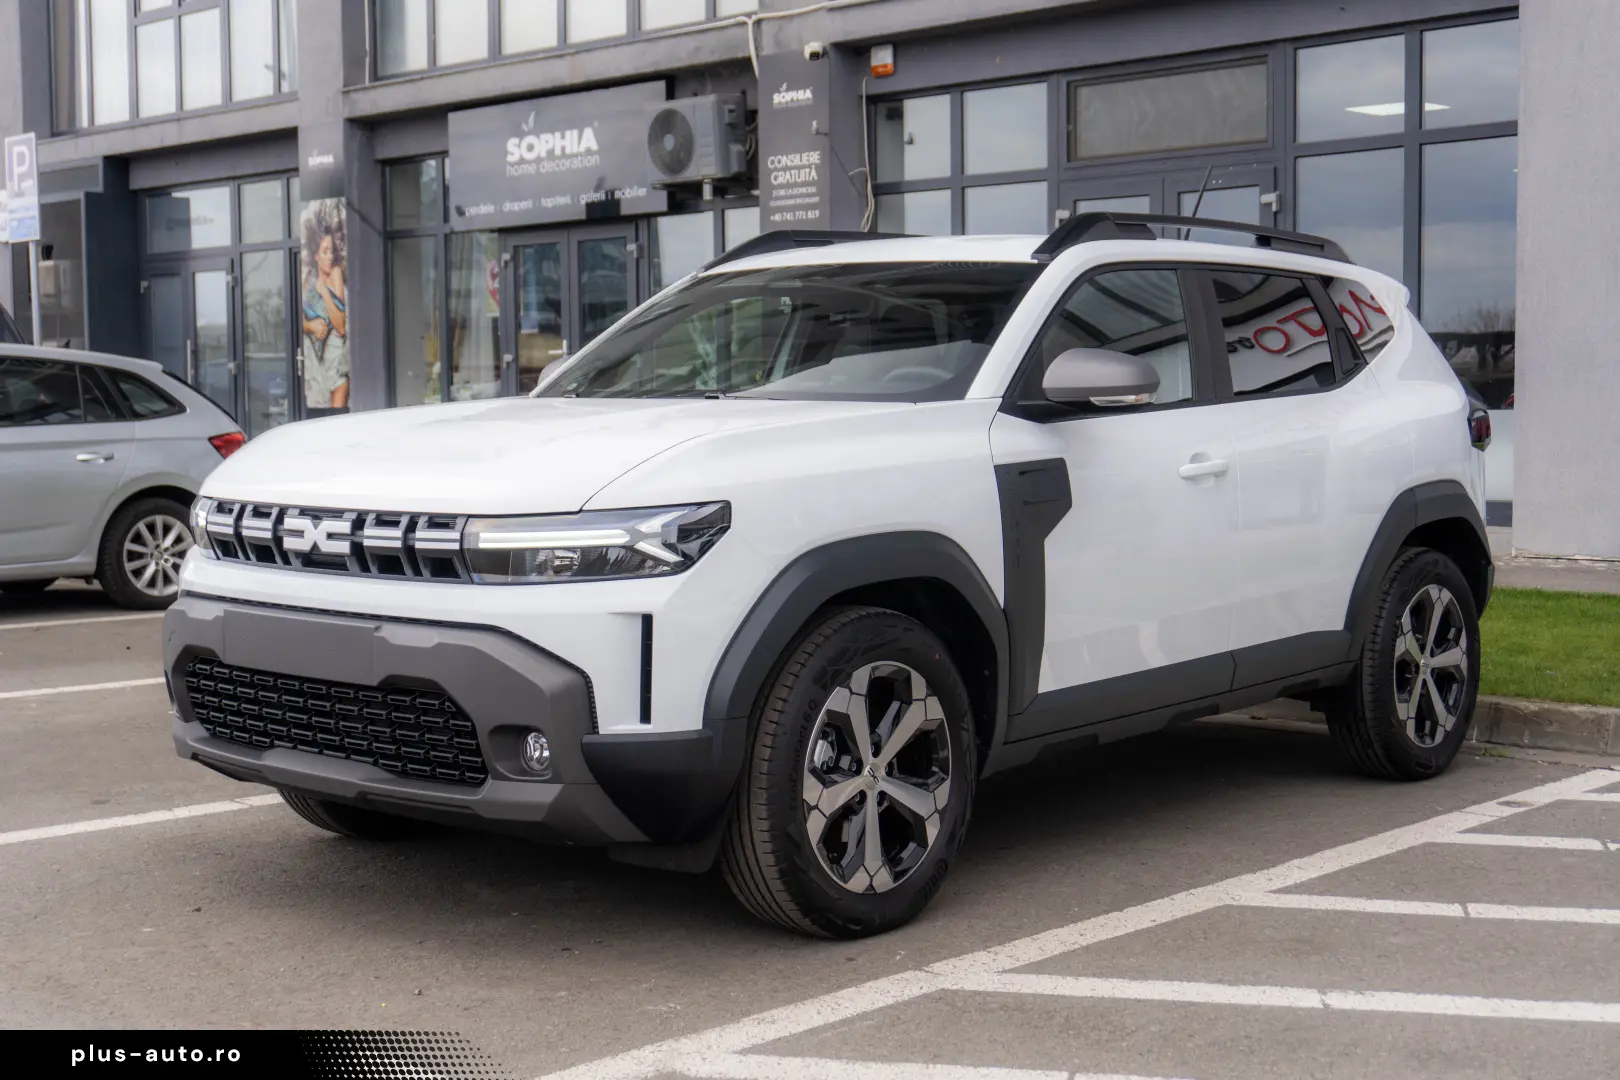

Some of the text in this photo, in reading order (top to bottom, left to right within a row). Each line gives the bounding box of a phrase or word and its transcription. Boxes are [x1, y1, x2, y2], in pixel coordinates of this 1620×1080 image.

[773, 88, 813, 104] SOPHIA
[506, 126, 599, 163] SOPHIA
[13, 145, 30, 193] P
[506, 154, 600, 177] home decoration
